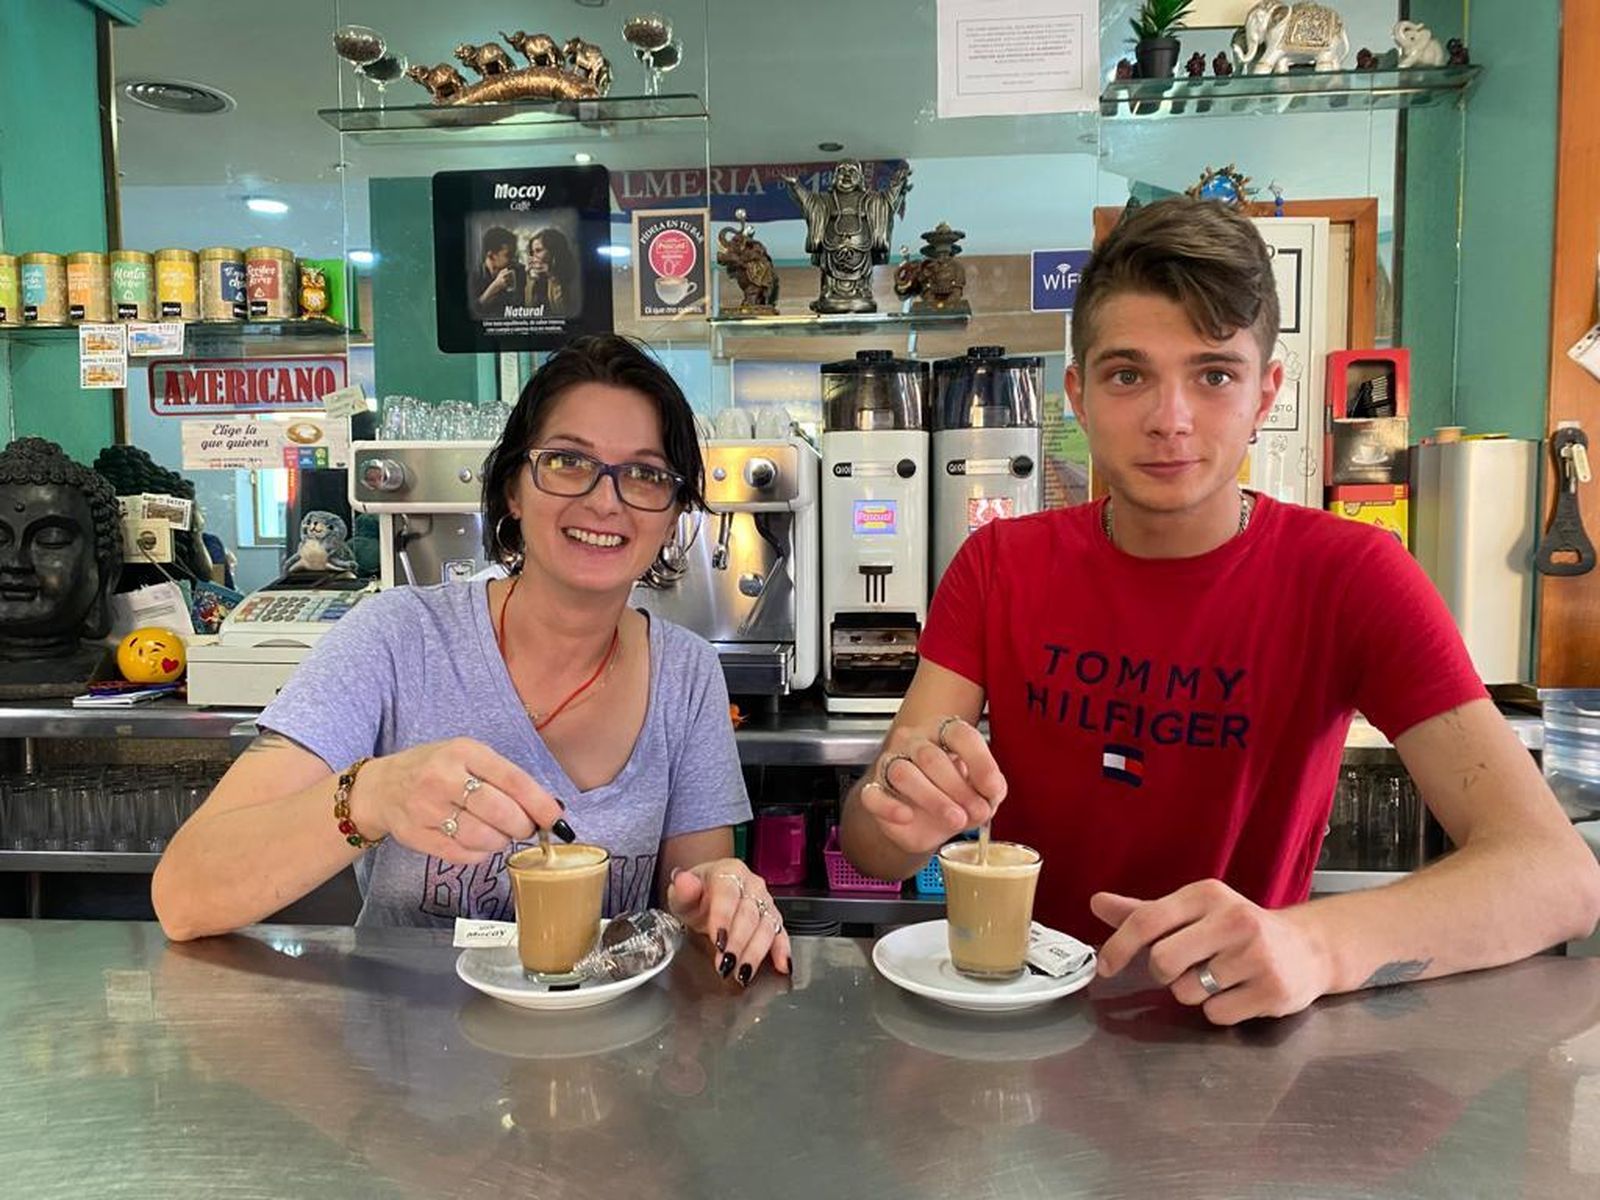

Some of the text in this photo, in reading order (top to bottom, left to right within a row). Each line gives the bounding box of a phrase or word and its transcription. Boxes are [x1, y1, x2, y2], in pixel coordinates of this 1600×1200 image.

[494, 183, 546, 201] Mocay
[504, 304, 545, 318] Natural
[163, 367, 337, 406] AMERICANO
[212, 422, 257, 437] Elige la
[200, 436, 269, 451] que quieres
[1044, 644, 1246, 701] TOMMY
[1026, 681, 1250, 749] HILFIGER
